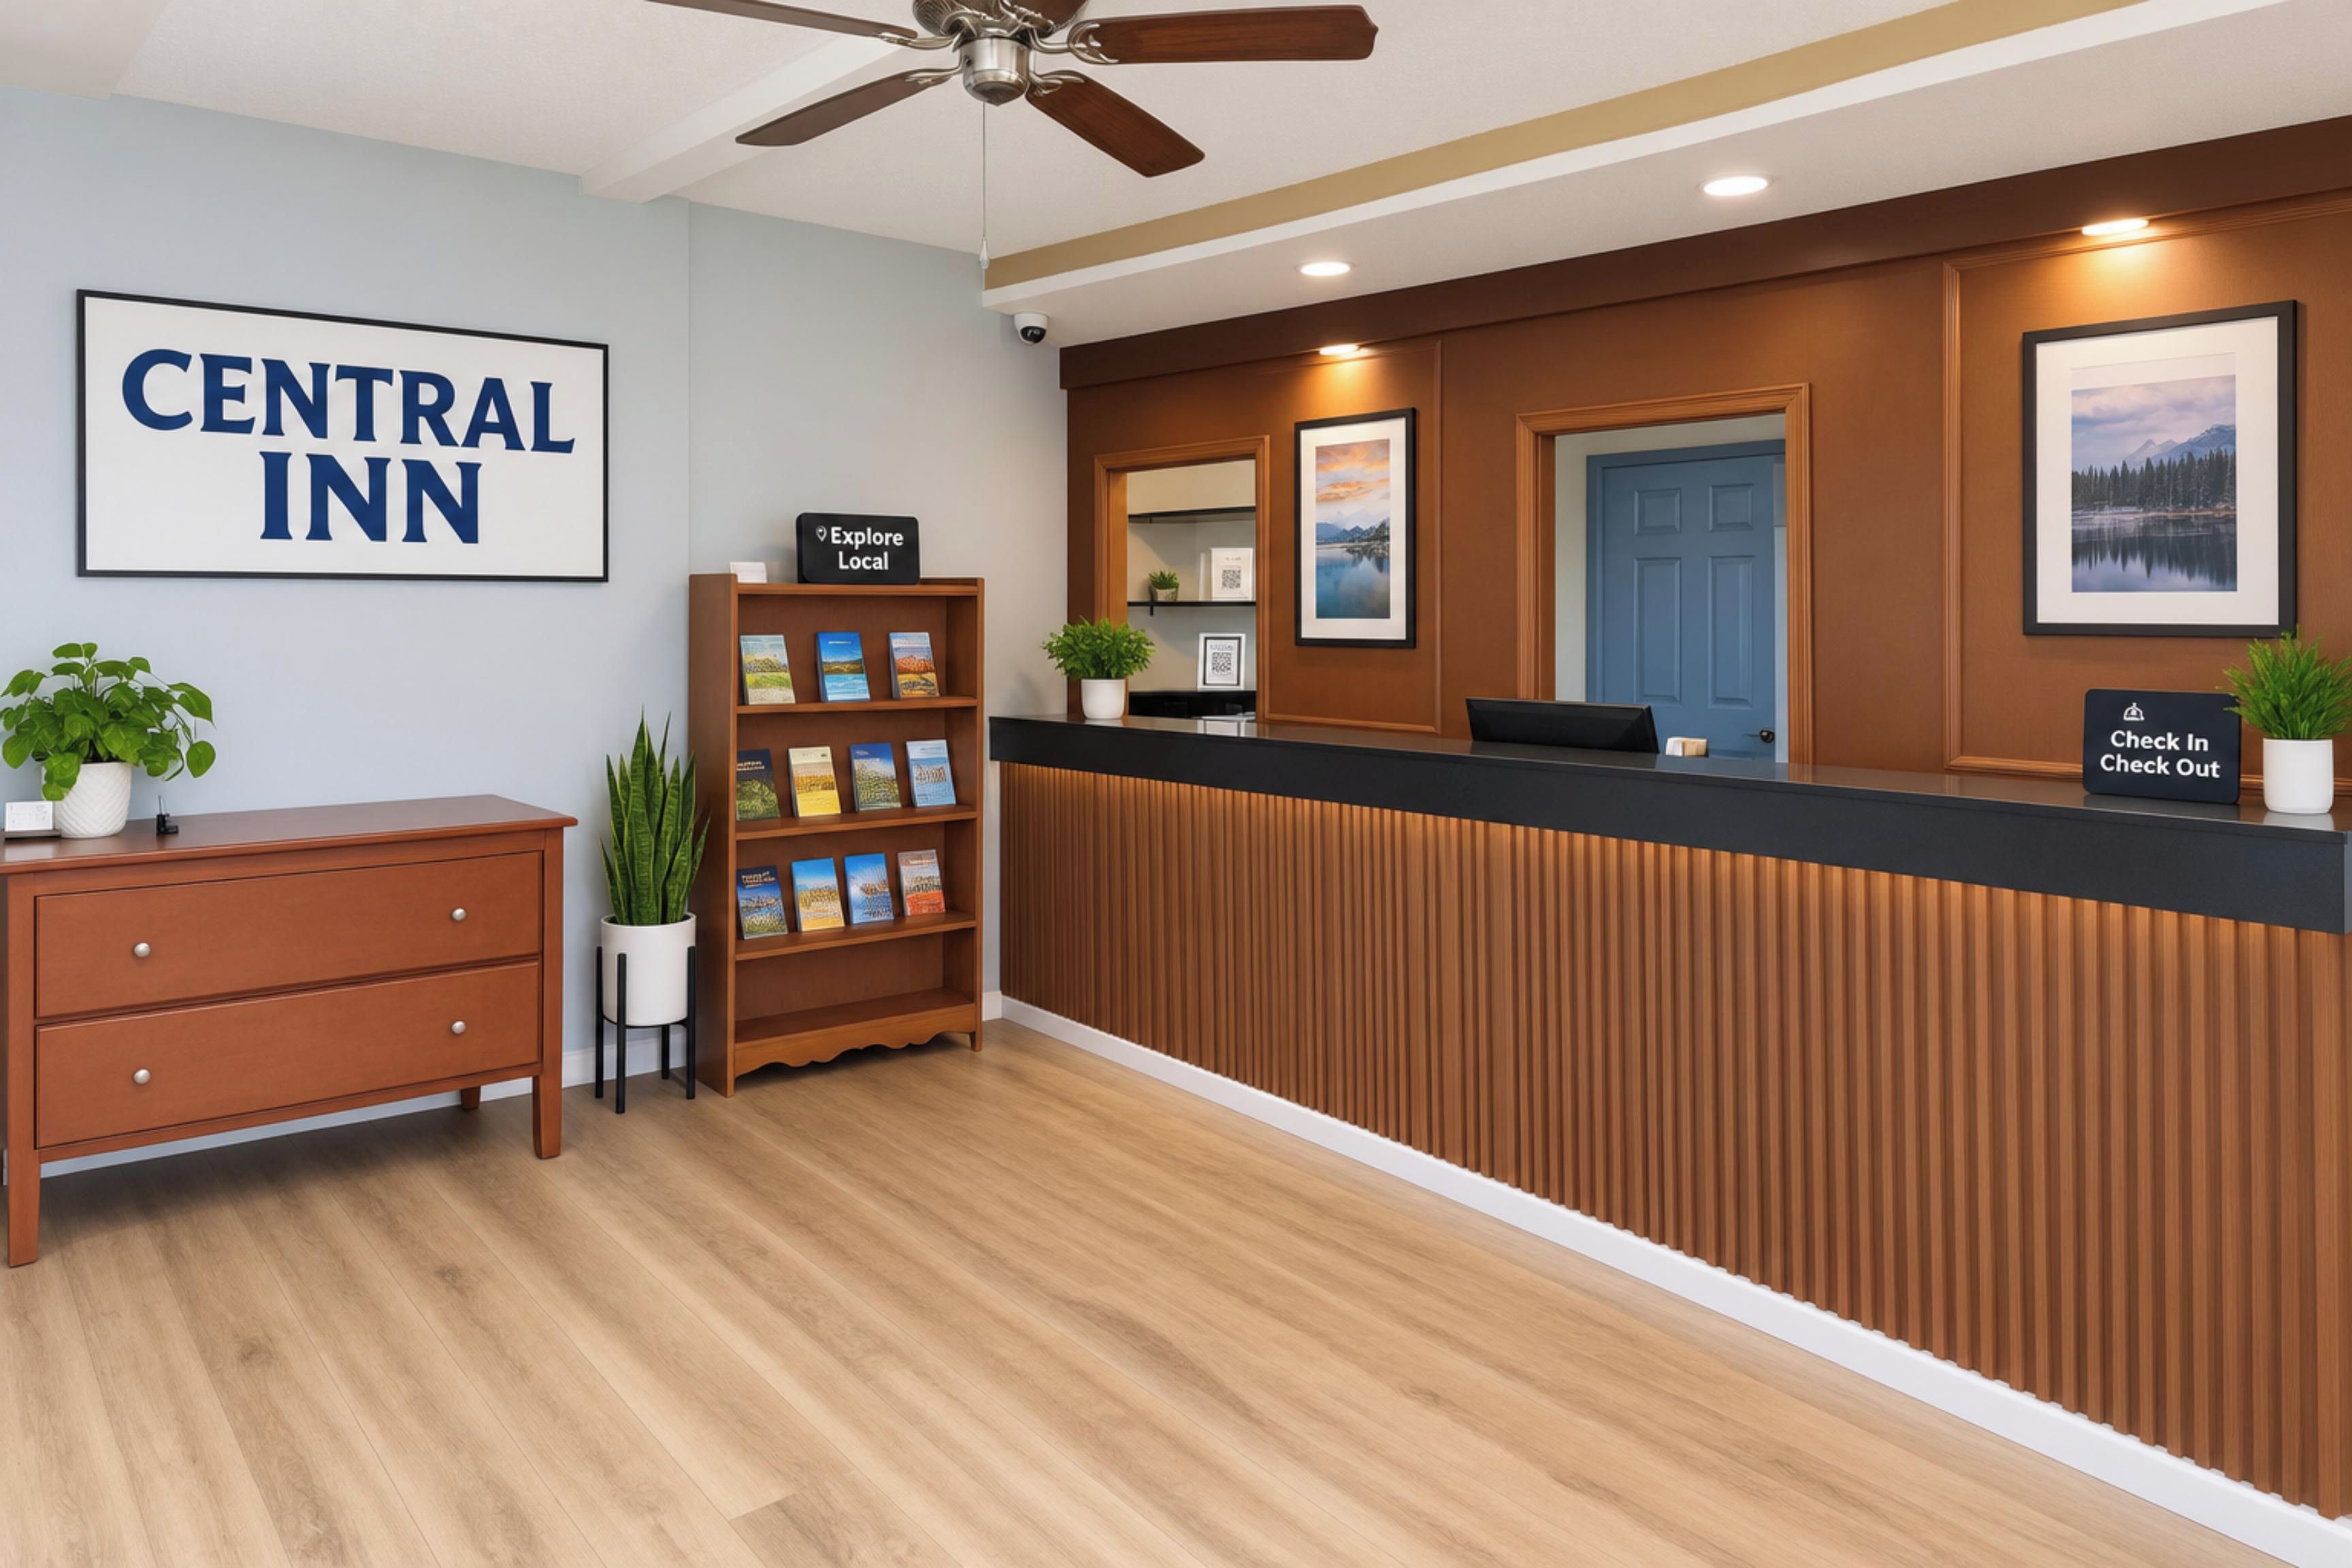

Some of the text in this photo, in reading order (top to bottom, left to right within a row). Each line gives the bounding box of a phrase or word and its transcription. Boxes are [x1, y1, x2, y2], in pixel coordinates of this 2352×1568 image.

[122, 348, 575, 454] CENTRAL
[259, 451, 482, 544] INN
[830, 526, 904, 551] Explore
[838, 551, 889, 570] Local
[2110, 730, 2209, 752] Check In
[2100, 753, 2221, 779] Check Out
